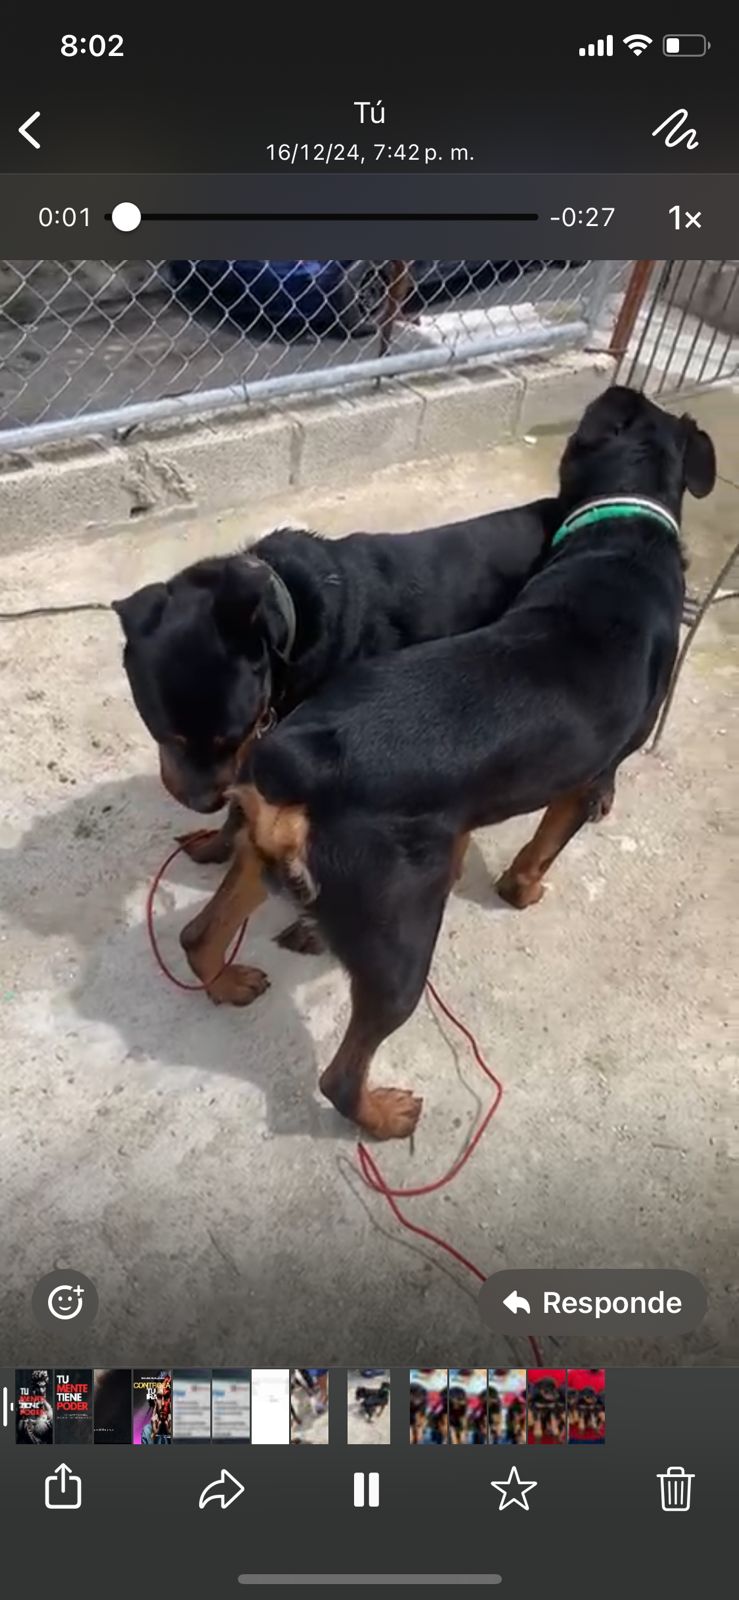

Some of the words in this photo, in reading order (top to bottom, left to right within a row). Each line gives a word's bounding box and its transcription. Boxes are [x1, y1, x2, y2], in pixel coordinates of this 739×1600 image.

[60, 34, 124, 58] 8:02
[353, 99, 385, 124] Tú
[266, 143, 365, 165] 16/12/24,
[373, 143, 420, 161] 7:42
[451, 147, 474, 161] m.
[38, 207, 91, 228] 0:01
[550, 207, 615, 228] -0:27
[542, 1290, 682, 1319] Responde
[57, 1375, 69, 1384] TU
[57, 1384, 88, 1393] MENTE
[20, 1387, 30, 1395] TU
[57, 1393, 82, 1402] TIENE
[57, 1402, 88, 1411] PODER
